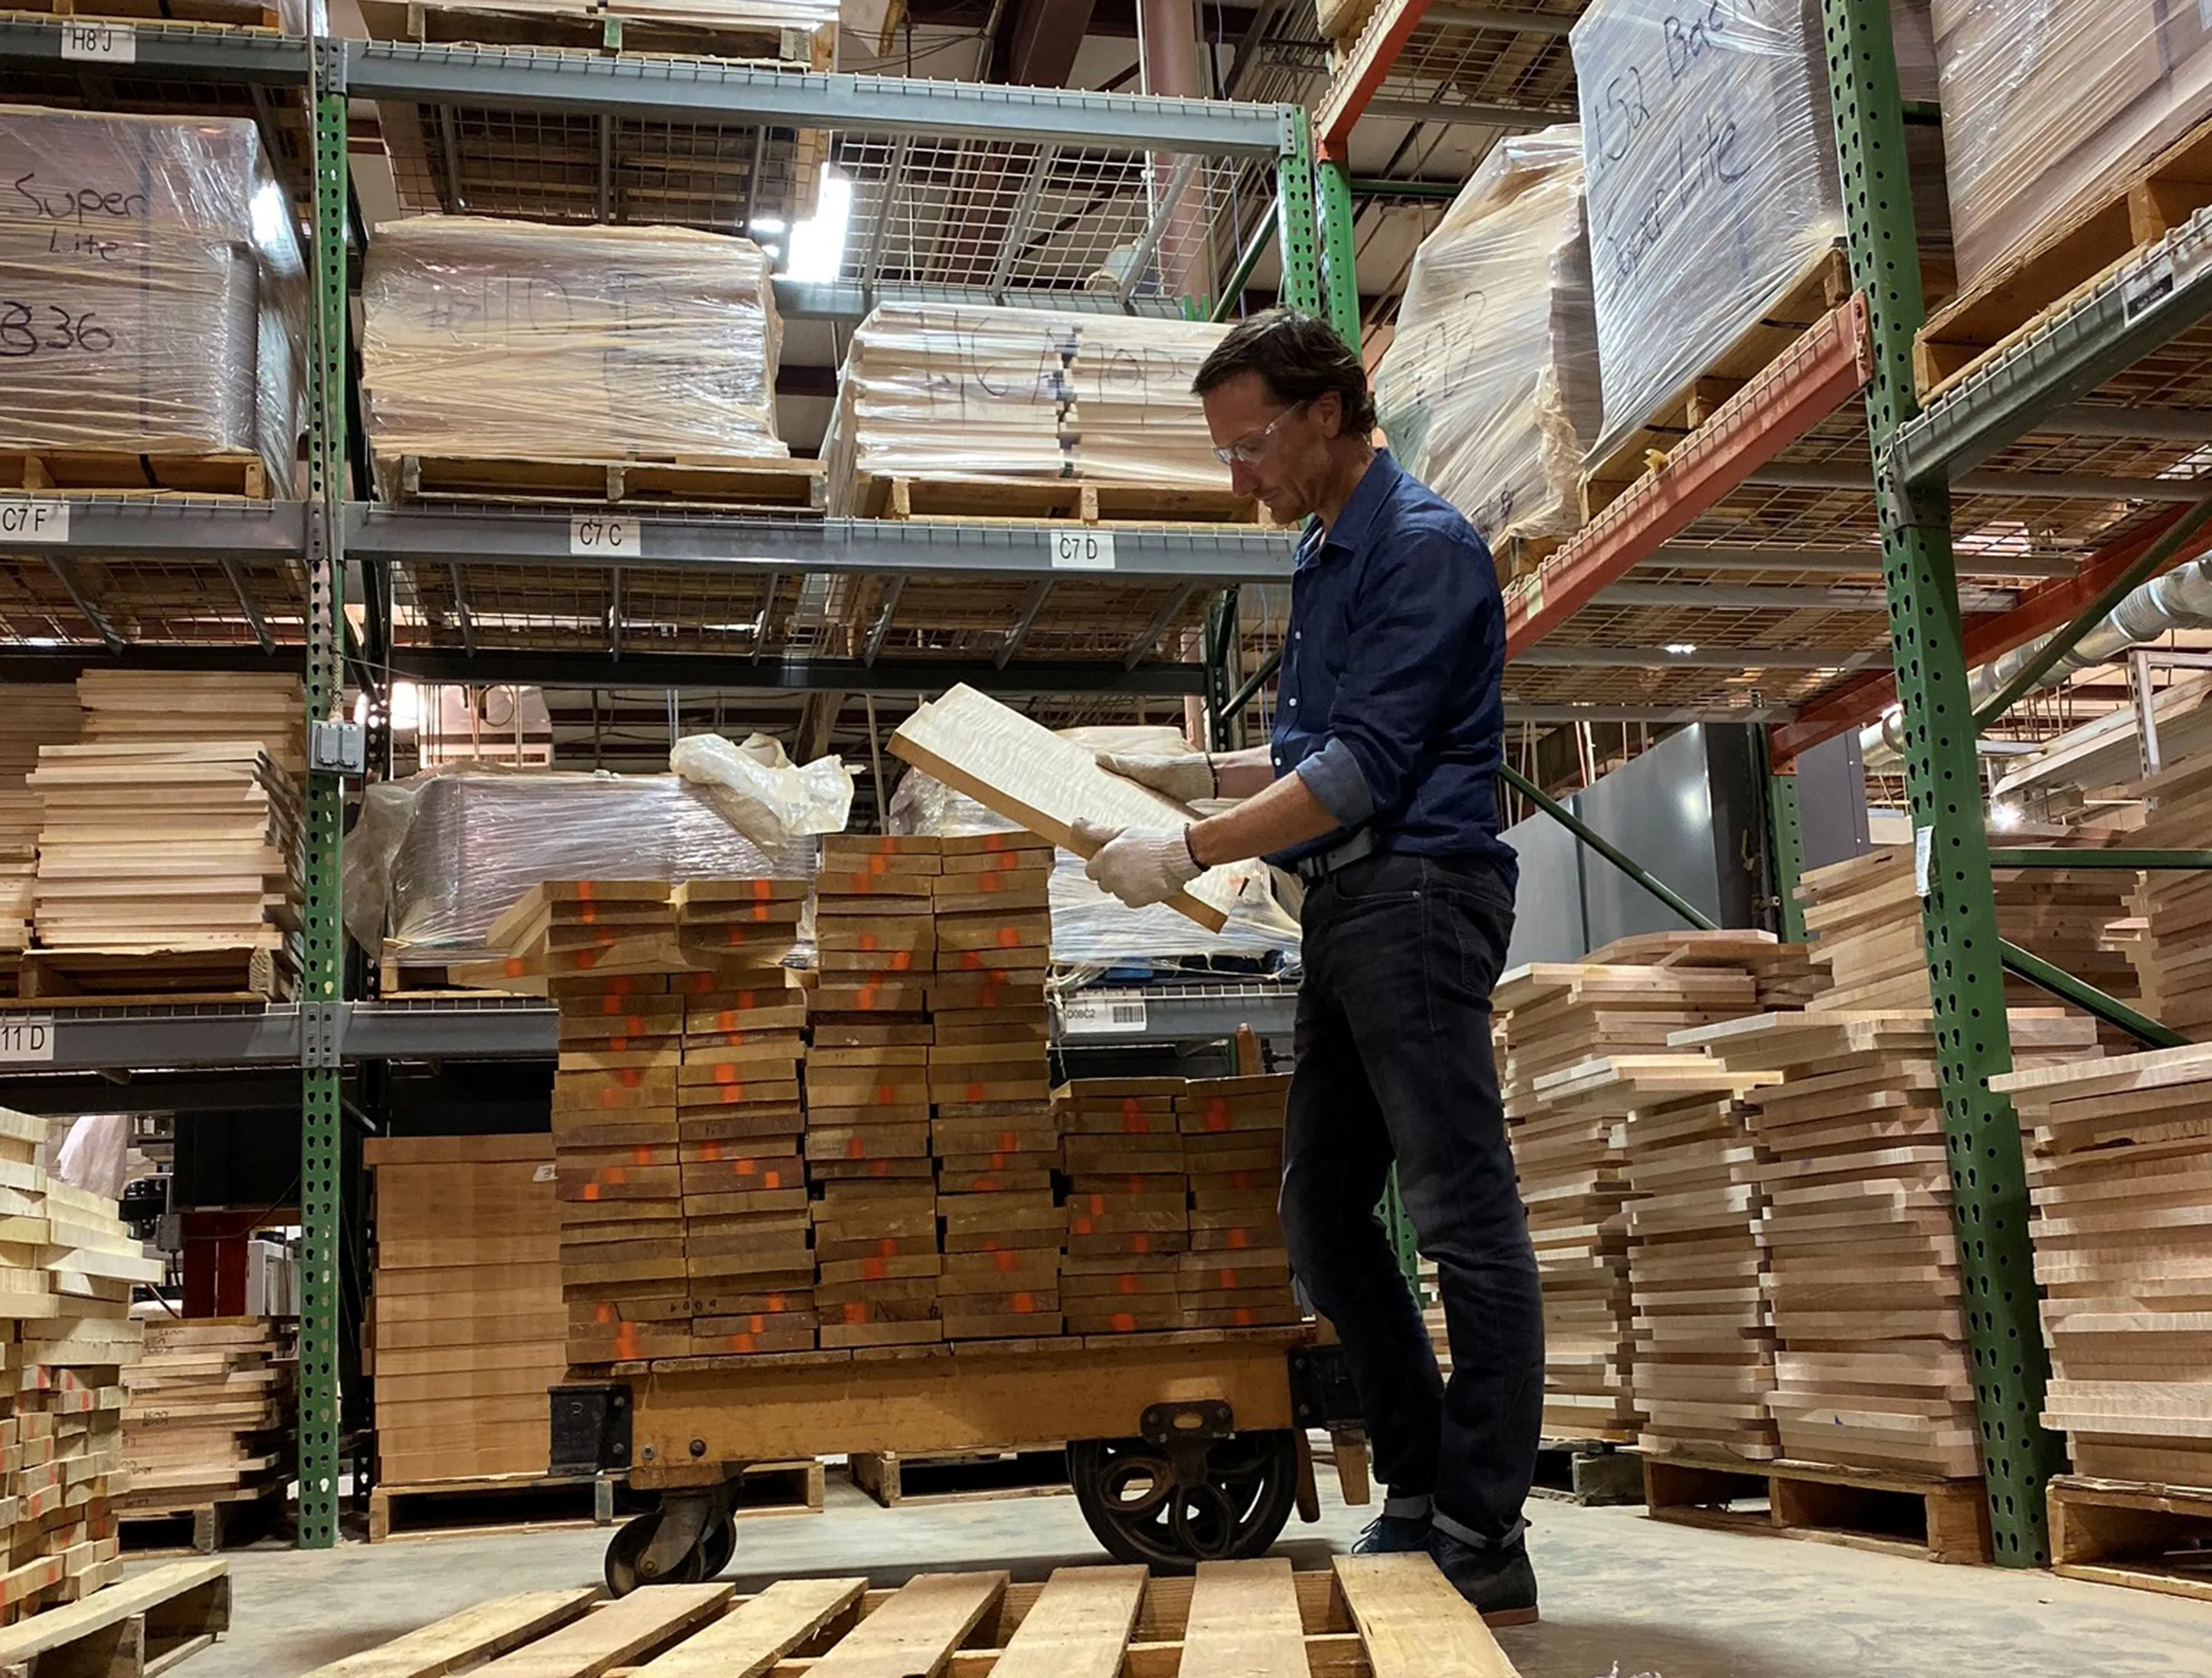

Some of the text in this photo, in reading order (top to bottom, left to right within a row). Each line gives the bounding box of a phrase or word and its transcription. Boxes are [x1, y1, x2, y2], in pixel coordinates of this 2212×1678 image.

[72, 29, 111, 52] H8 J
[15, 173, 146, 224] Super
[49, 228, 125, 262] Lite
[2, 507, 47, 532] C7 F
[580, 522, 622, 546] C7 C
[1059, 538, 1098, 559] C7 D
[31, 1025, 45, 1050] D
